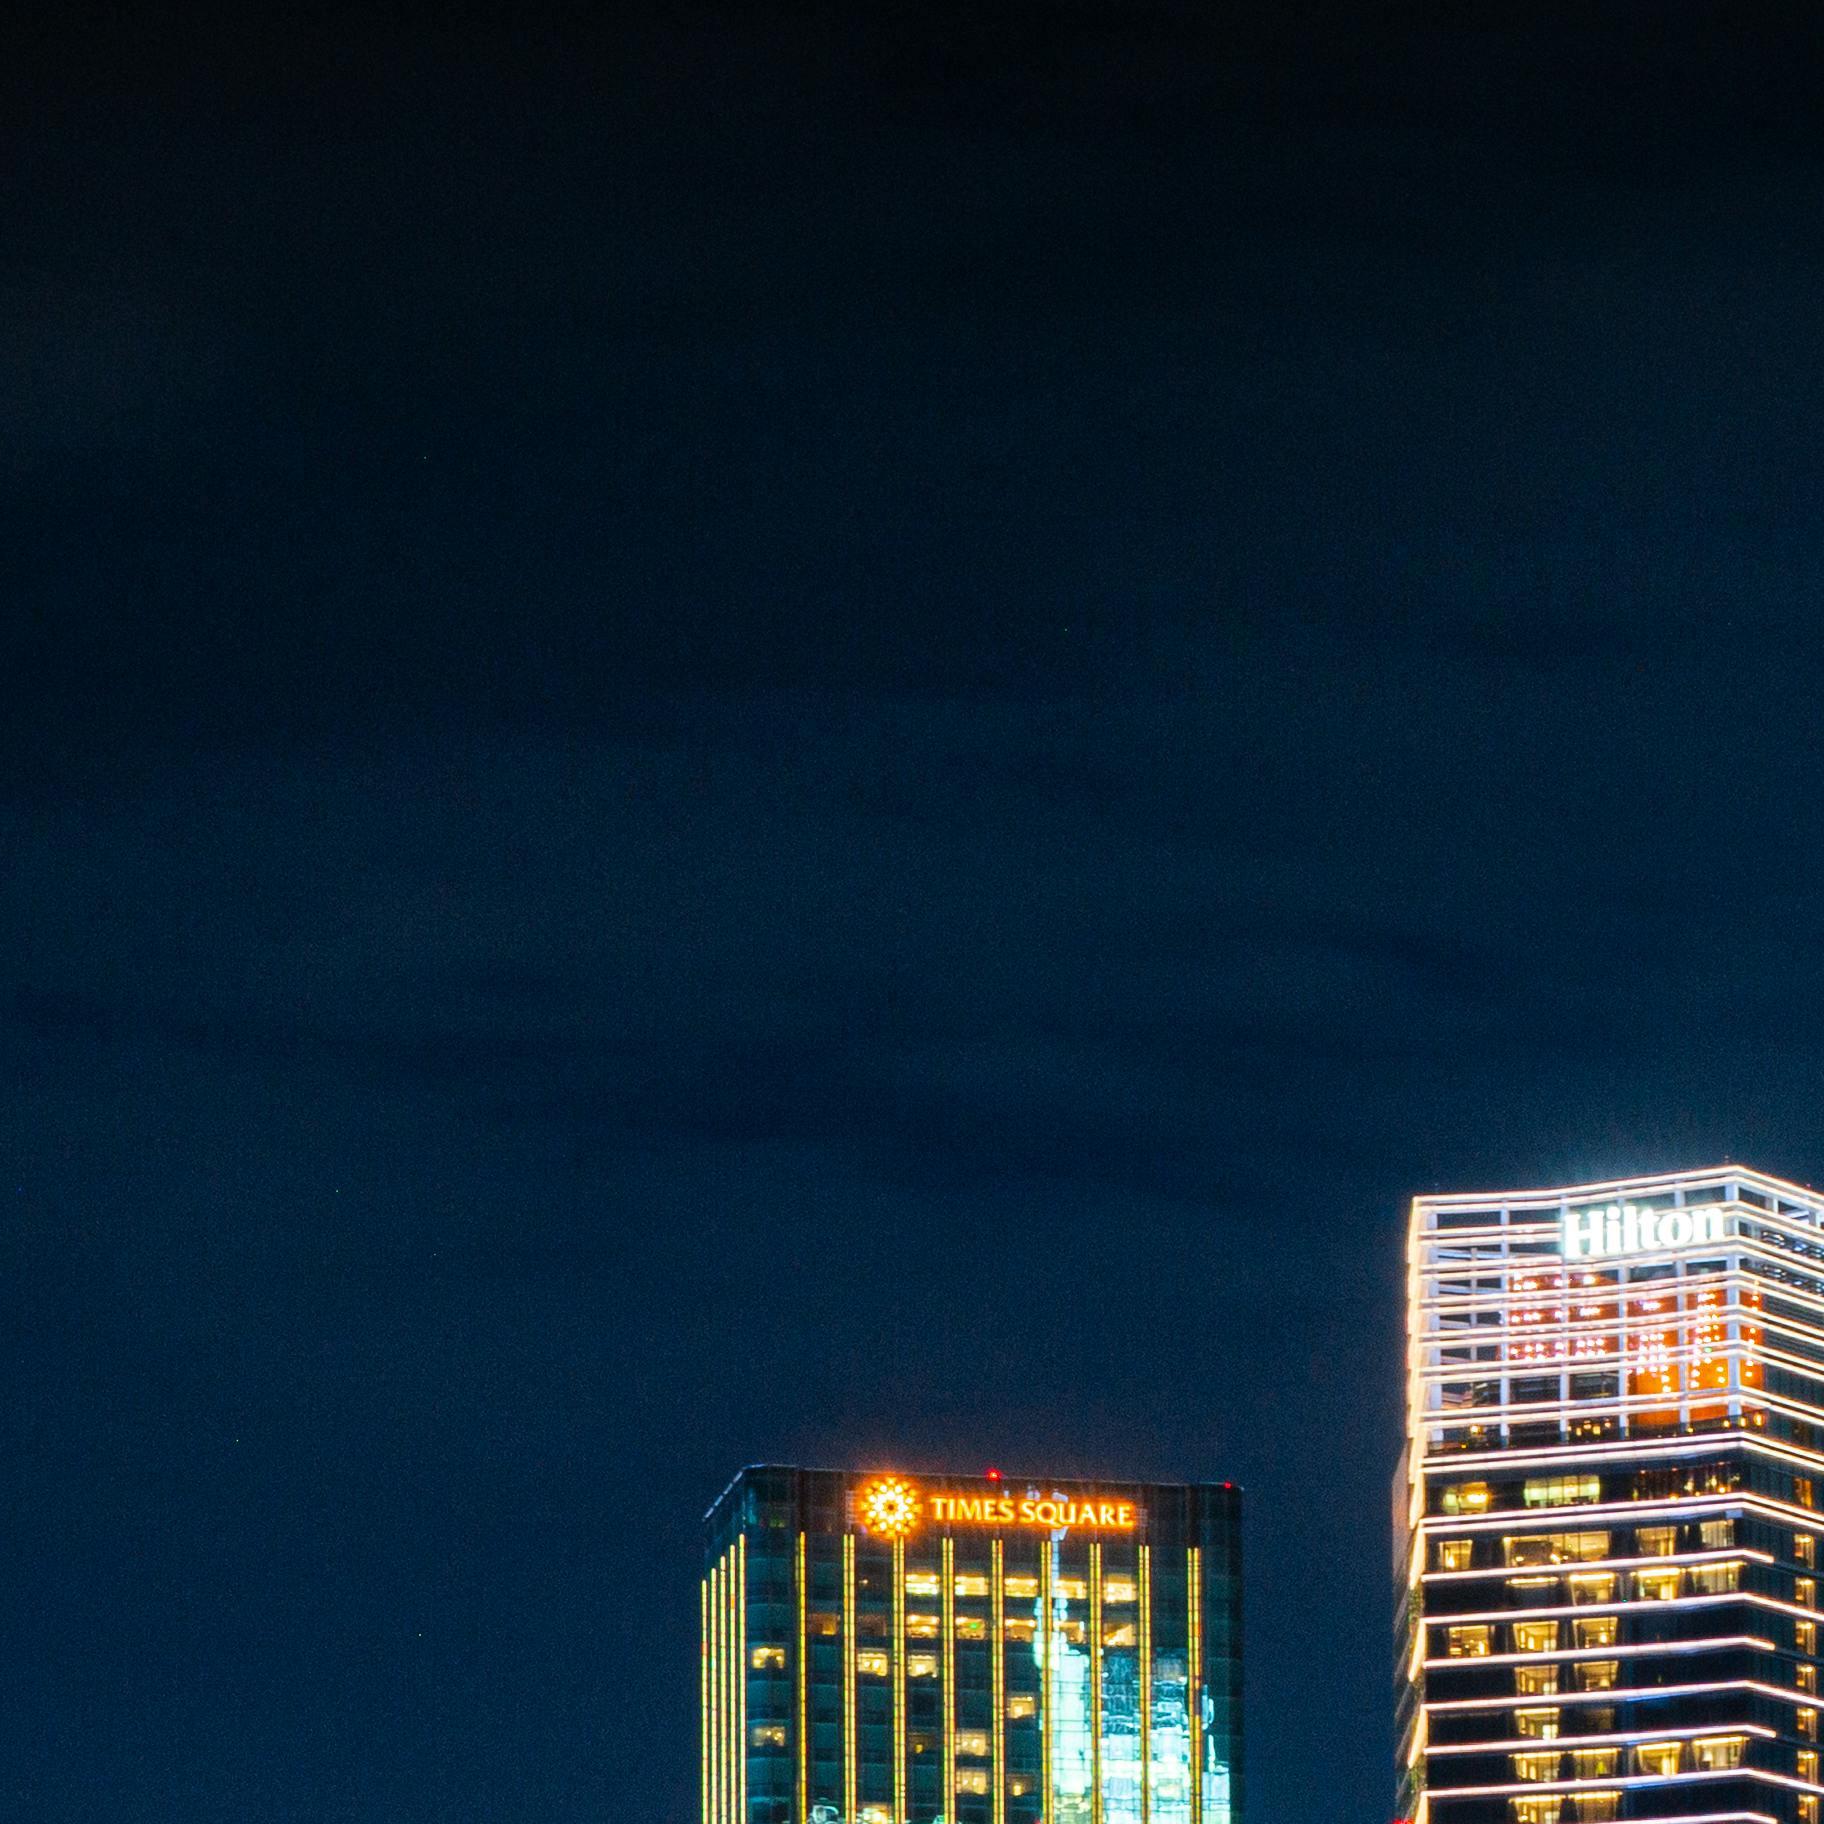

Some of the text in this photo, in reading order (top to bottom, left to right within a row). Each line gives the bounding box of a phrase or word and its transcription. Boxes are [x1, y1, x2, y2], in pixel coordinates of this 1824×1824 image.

[1564, 1205, 1725, 1260] Hilton
[931, 1498, 1134, 1528] TIMES SQUARE
